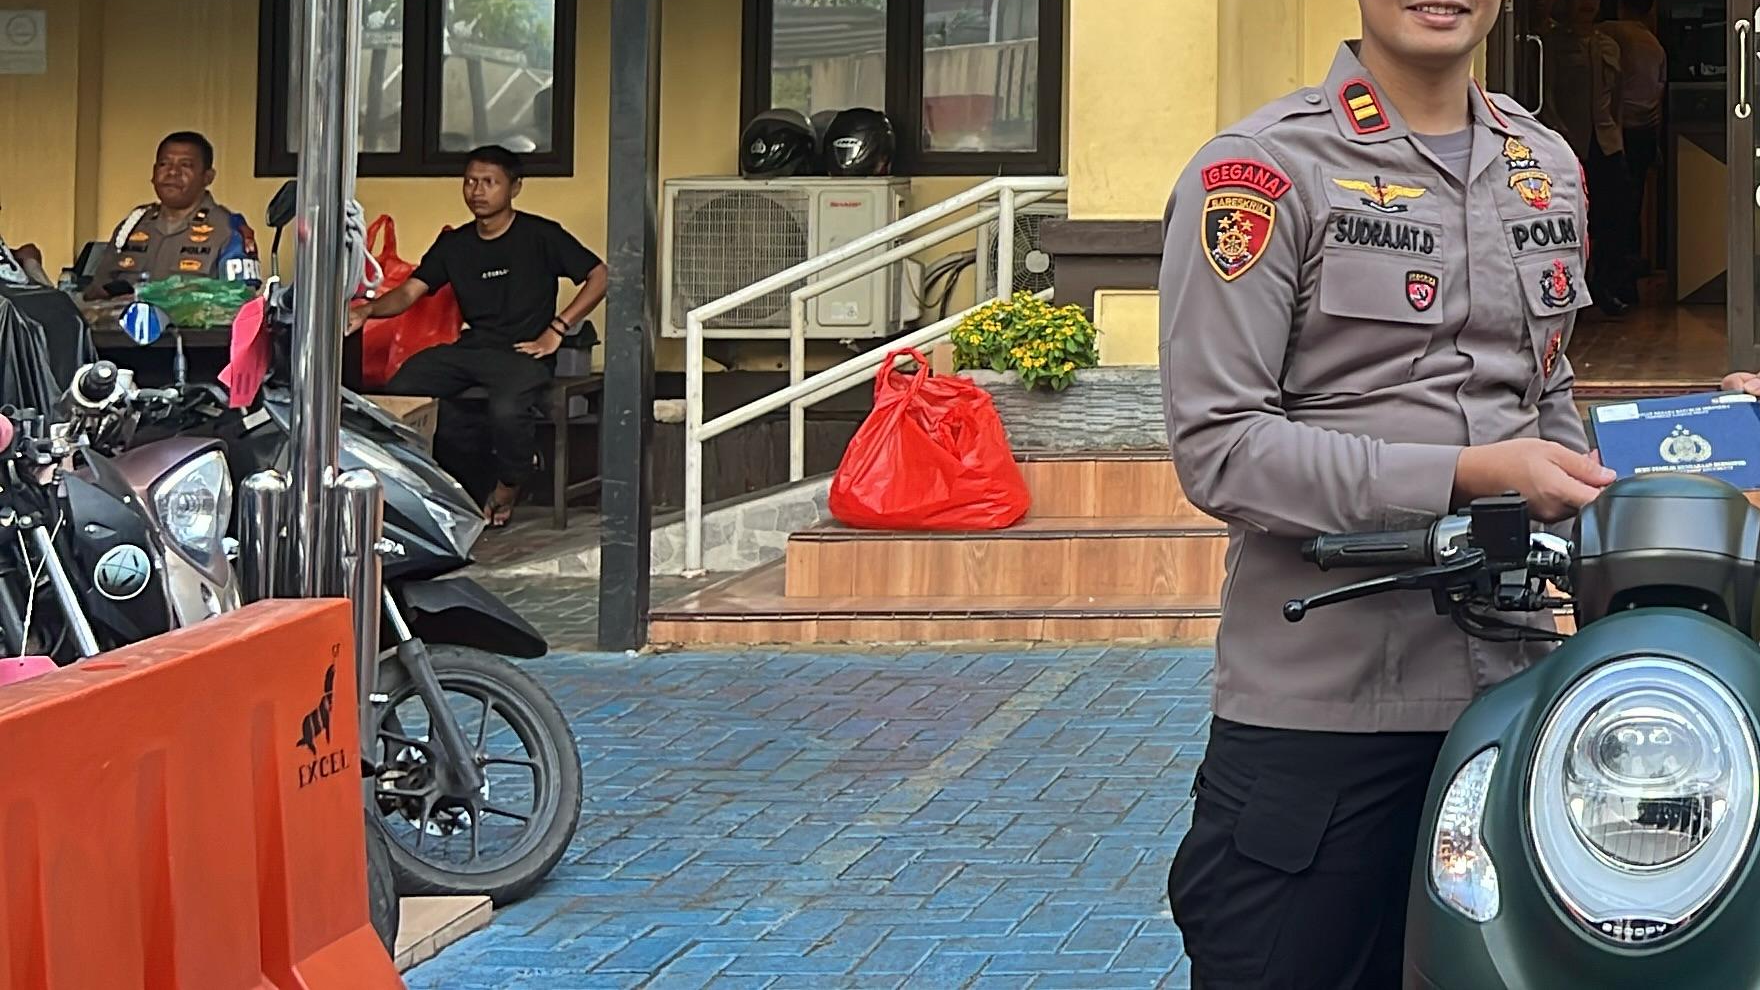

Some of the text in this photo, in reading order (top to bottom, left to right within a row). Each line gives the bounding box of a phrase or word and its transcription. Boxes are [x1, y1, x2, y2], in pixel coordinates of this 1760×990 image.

[1208, 164, 1281, 194] GEGANA
[1211, 197, 1269, 214] BARESKRIM
[298, 748, 350, 789] EXCEL
